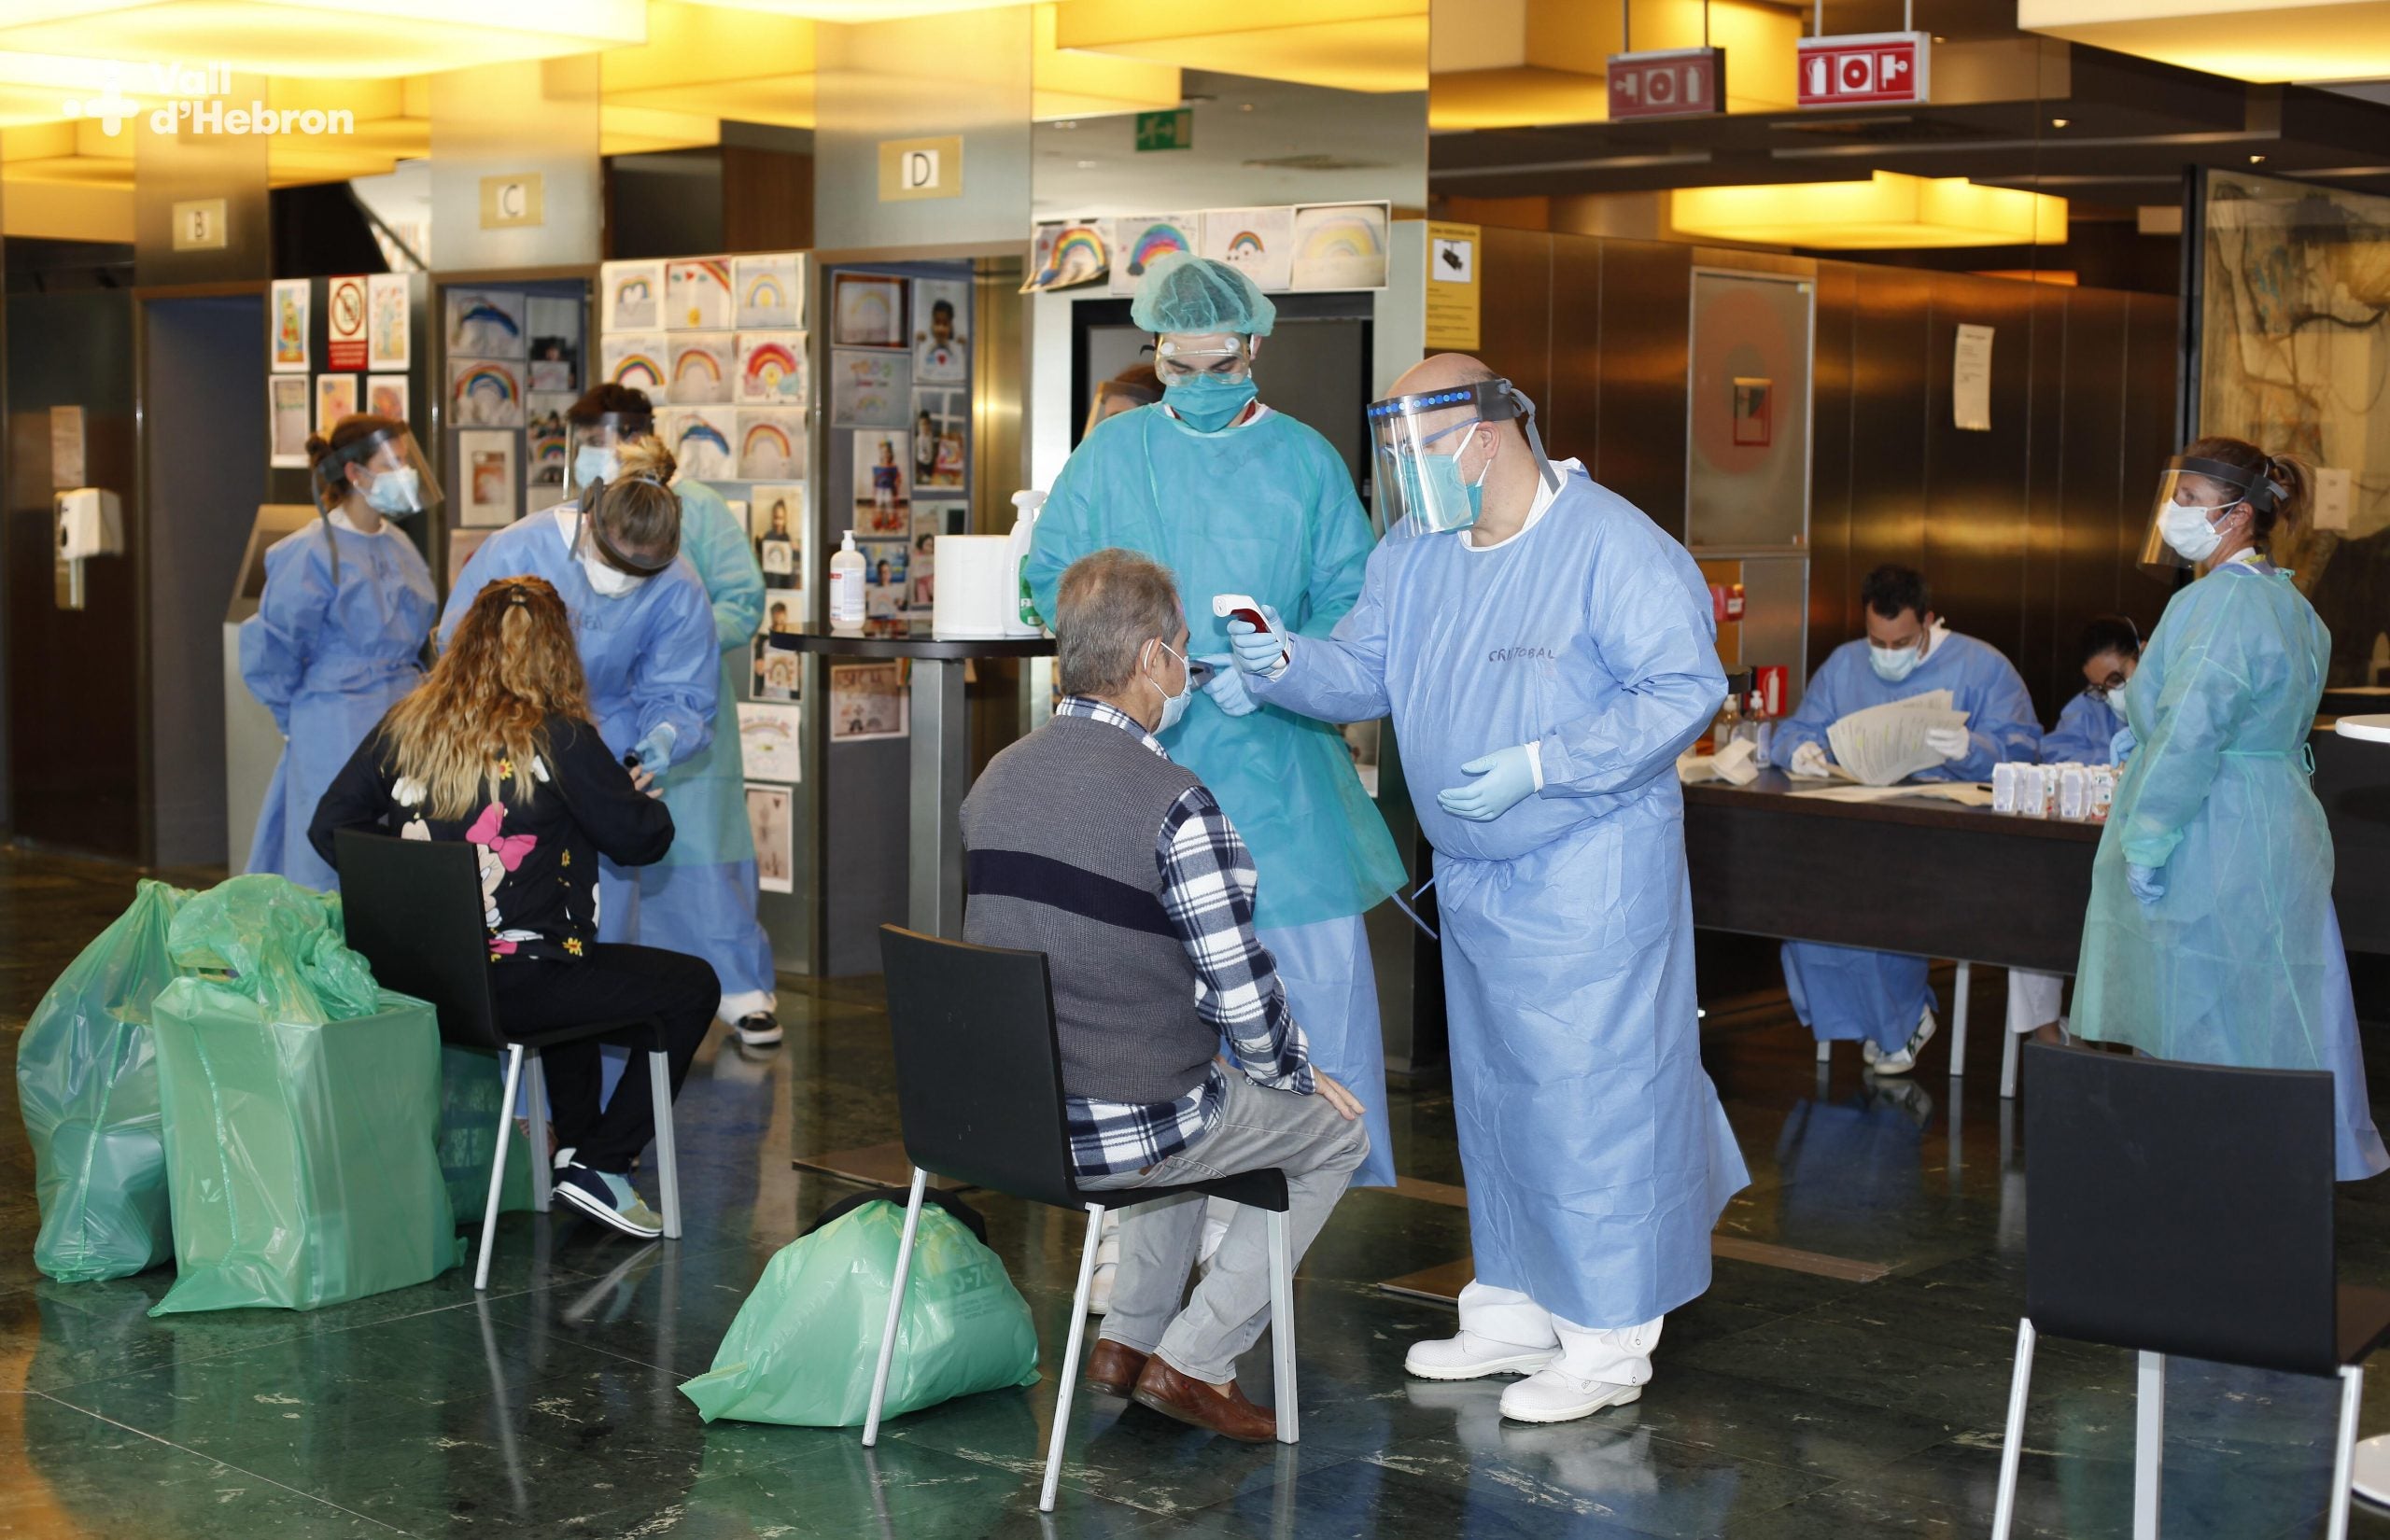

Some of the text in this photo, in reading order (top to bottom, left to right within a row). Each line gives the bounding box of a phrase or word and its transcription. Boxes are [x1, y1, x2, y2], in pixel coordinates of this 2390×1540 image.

[911, 152, 931, 187] D
[503, 184, 519, 217] C
[194, 210, 204, 239] B
